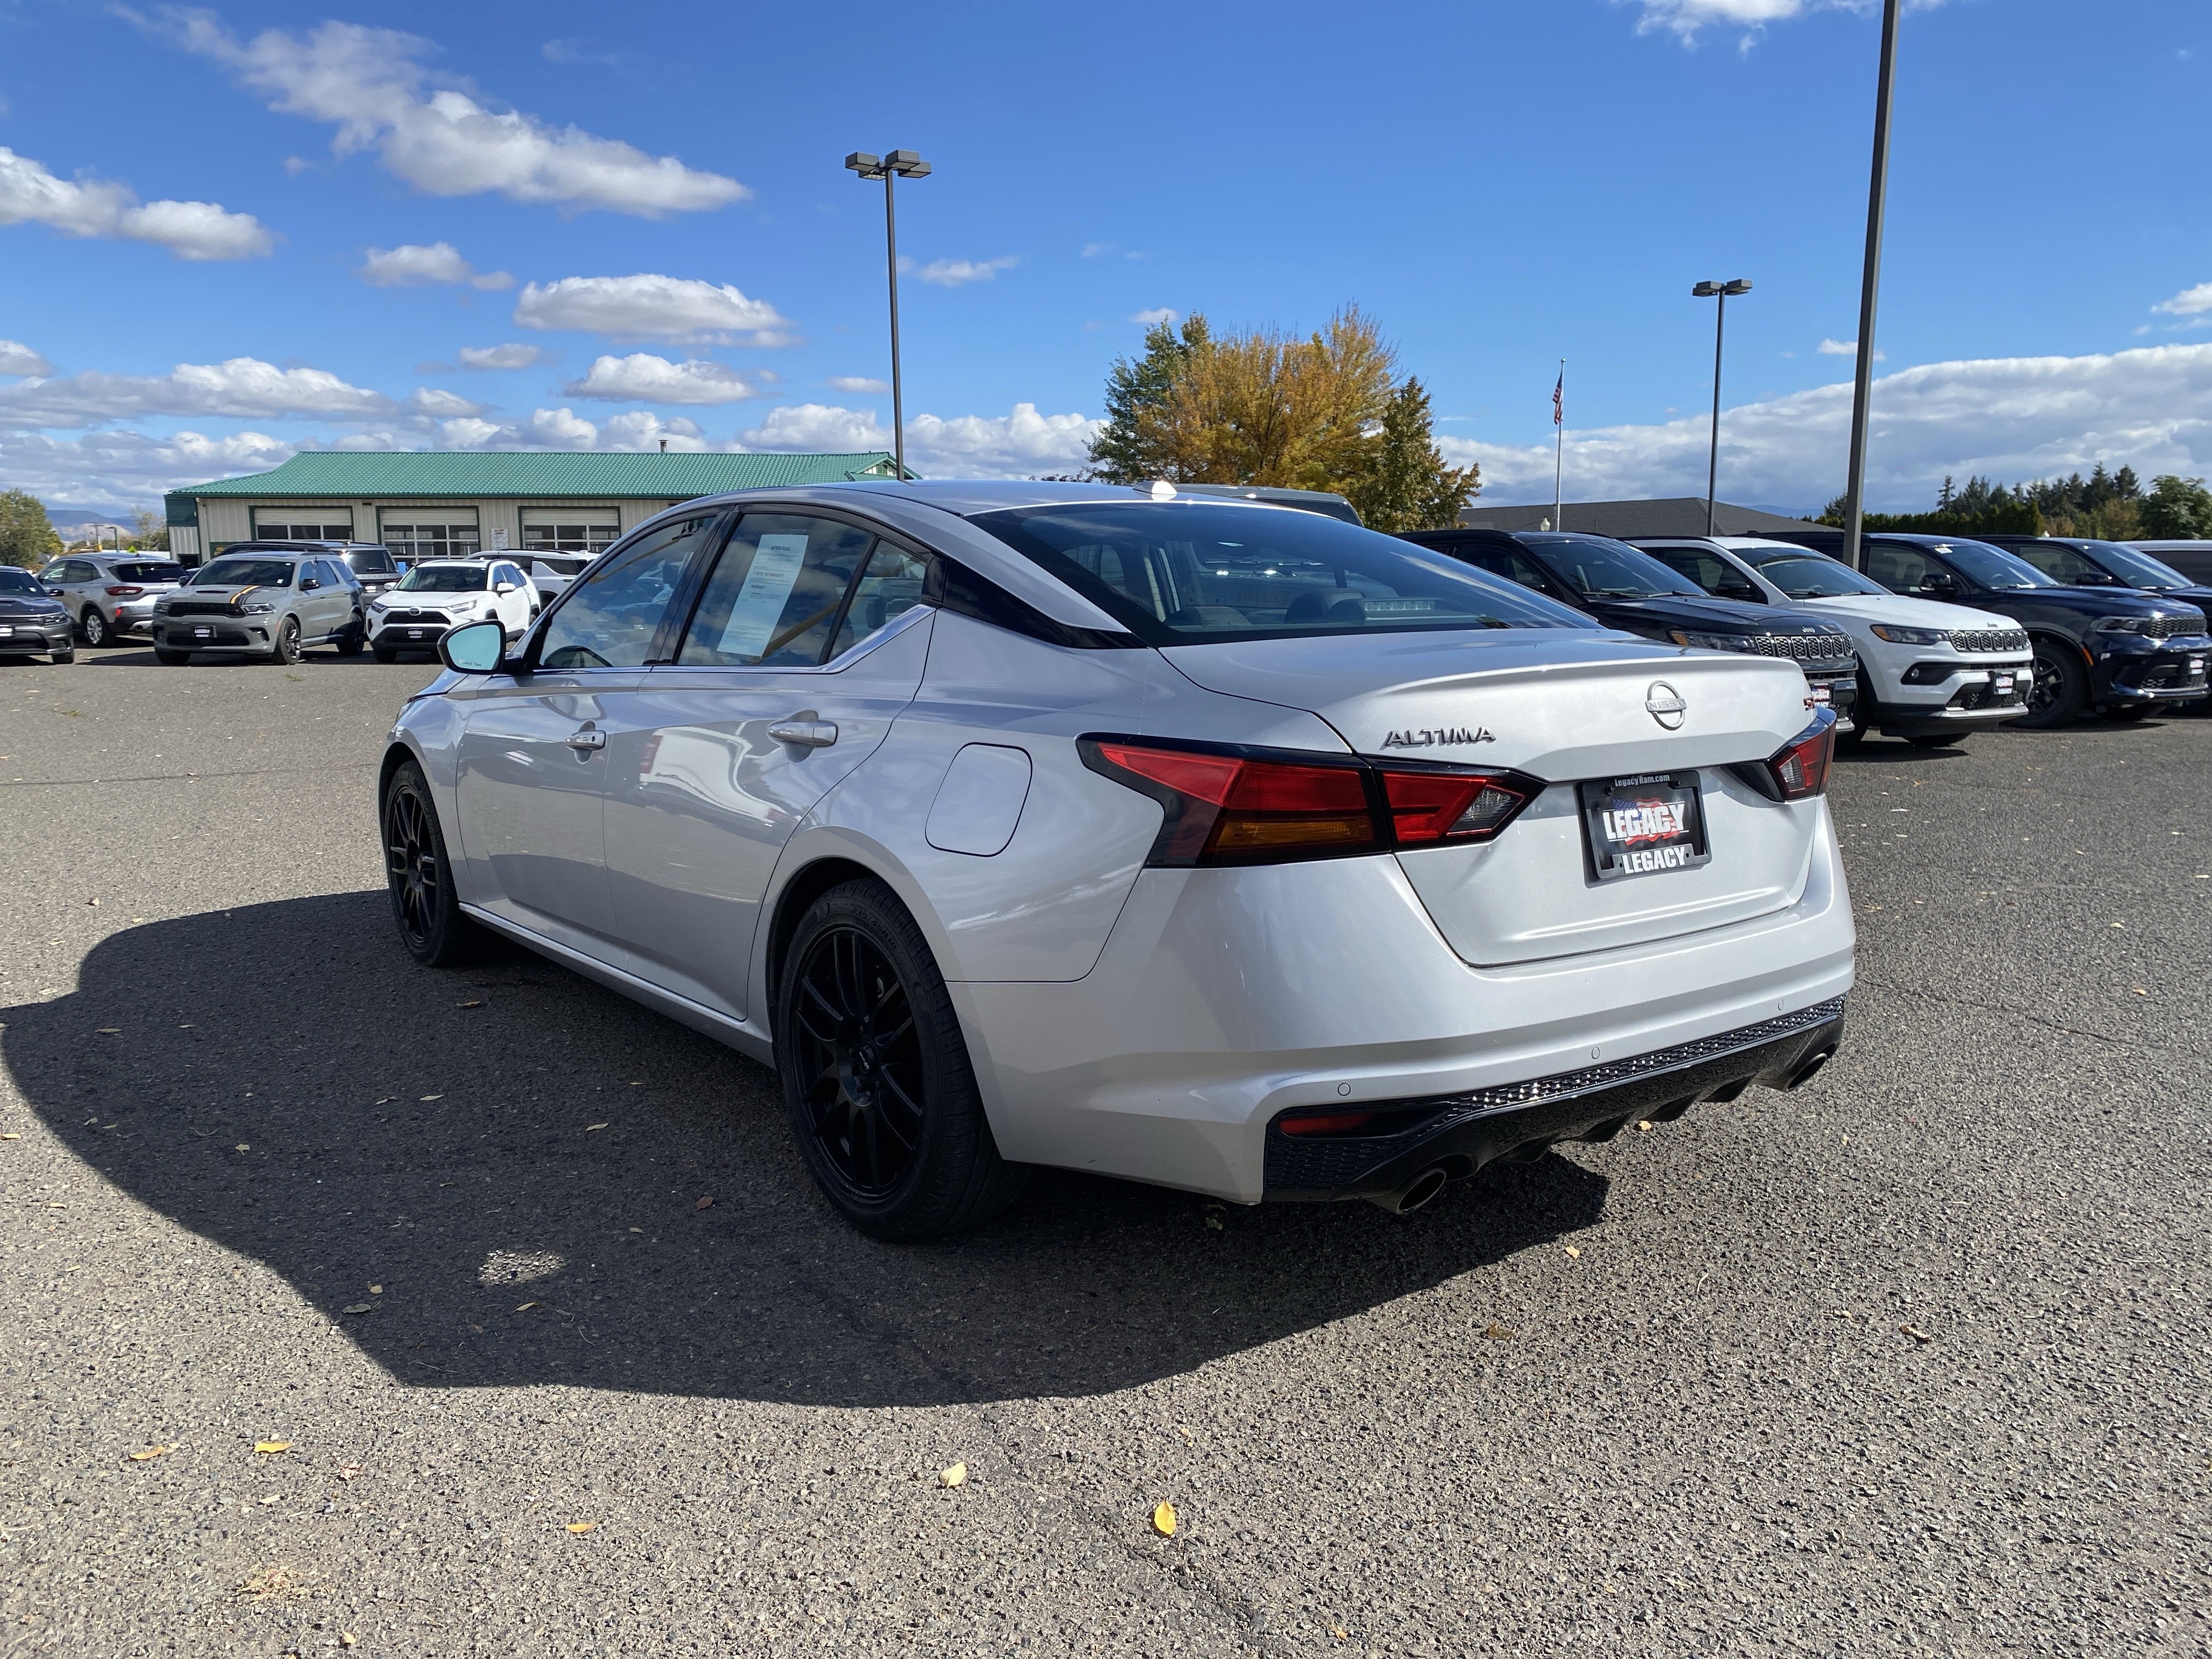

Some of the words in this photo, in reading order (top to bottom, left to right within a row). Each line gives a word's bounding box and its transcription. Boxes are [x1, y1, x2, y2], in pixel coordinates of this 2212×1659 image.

[1647, 698, 1687, 710] NISSAN
[1384, 727, 1497, 747] ALTIMA
[1602, 803, 1685, 840] LEGACY
[1622, 846, 1685, 874] LEGACY
[851, 908, 898, 950] 235/45R18
